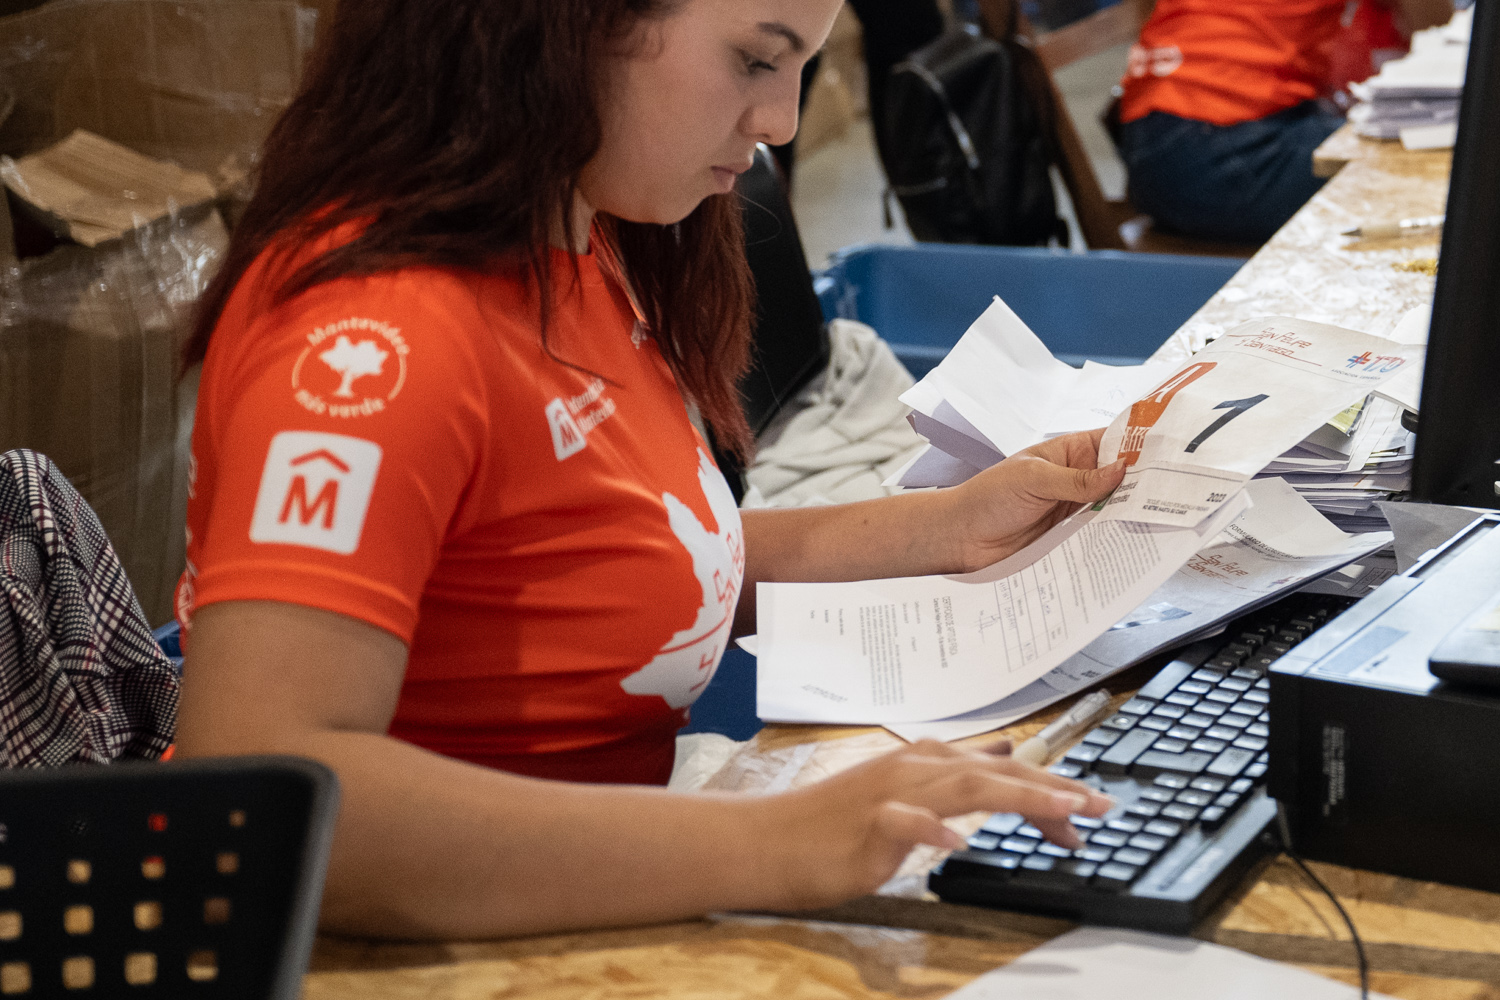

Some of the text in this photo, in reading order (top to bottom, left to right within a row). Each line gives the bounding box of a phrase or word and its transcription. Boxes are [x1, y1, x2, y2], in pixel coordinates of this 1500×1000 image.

[307, 317, 410, 355] Montevideo
[1184, 394, 1270, 454] 1
[278, 474, 339, 531] M
